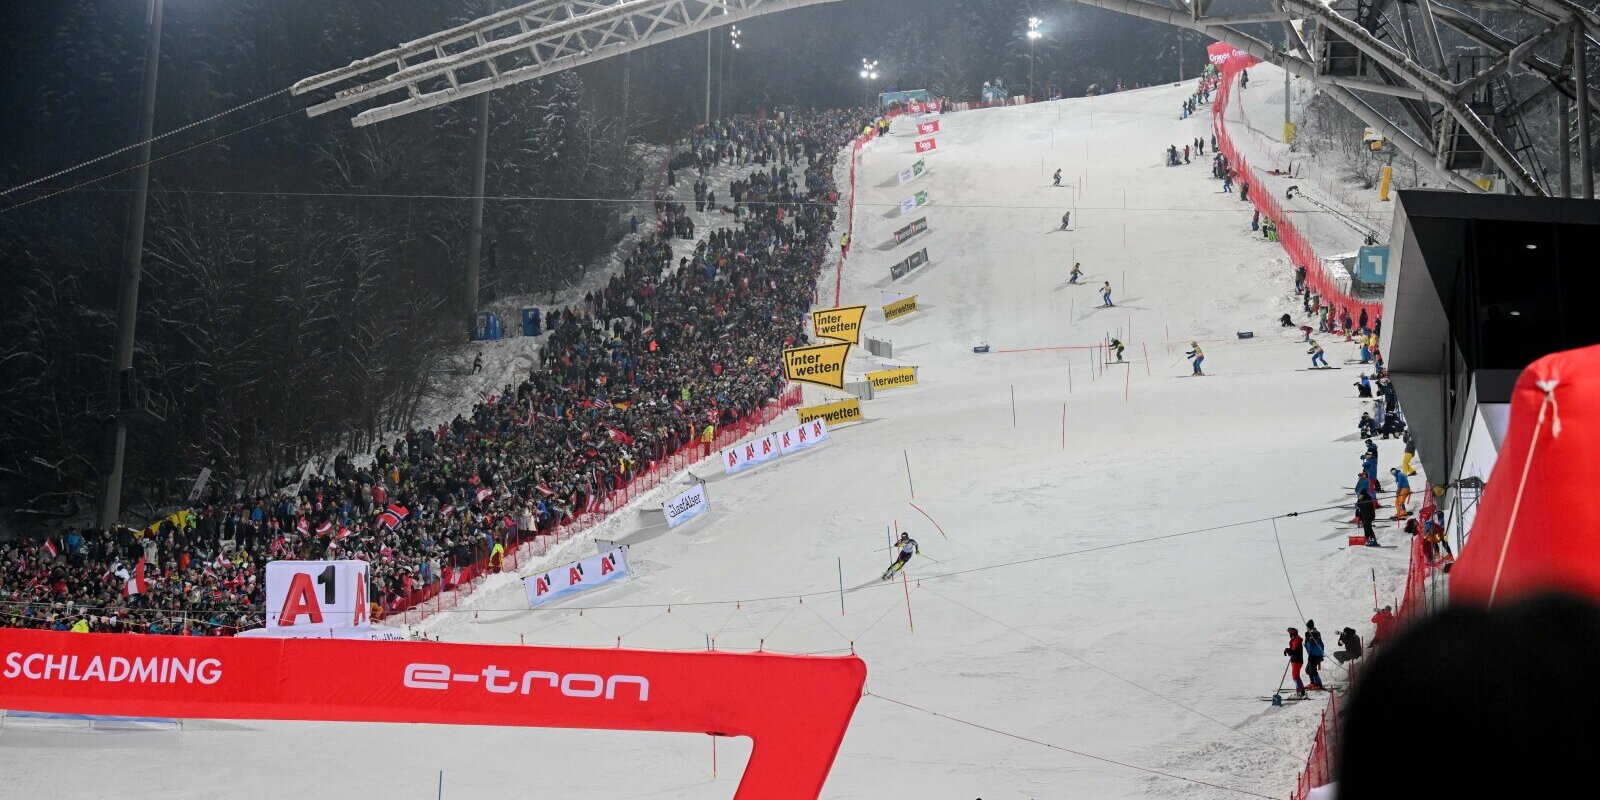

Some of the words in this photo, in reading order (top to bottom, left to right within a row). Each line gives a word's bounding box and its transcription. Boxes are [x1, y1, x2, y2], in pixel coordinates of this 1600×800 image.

[1368, 256, 1382, 275] 1
[817, 312, 842, 325] inter
[884, 302, 916, 318] interwetten
[822, 321, 857, 333] wetten
[790, 351, 821, 366] inter
[796, 361, 840, 376] wetten
[813, 420, 822, 438] A1
[762, 437, 772, 454] A1
[536, 573, 551, 596] A1
[569, 562, 584, 586] A1
[601, 552, 616, 576] A1
[278, 564, 336, 627] A1
[3, 652, 222, 685] SCHLADMING
[403, 662, 650, 702] e-tron
